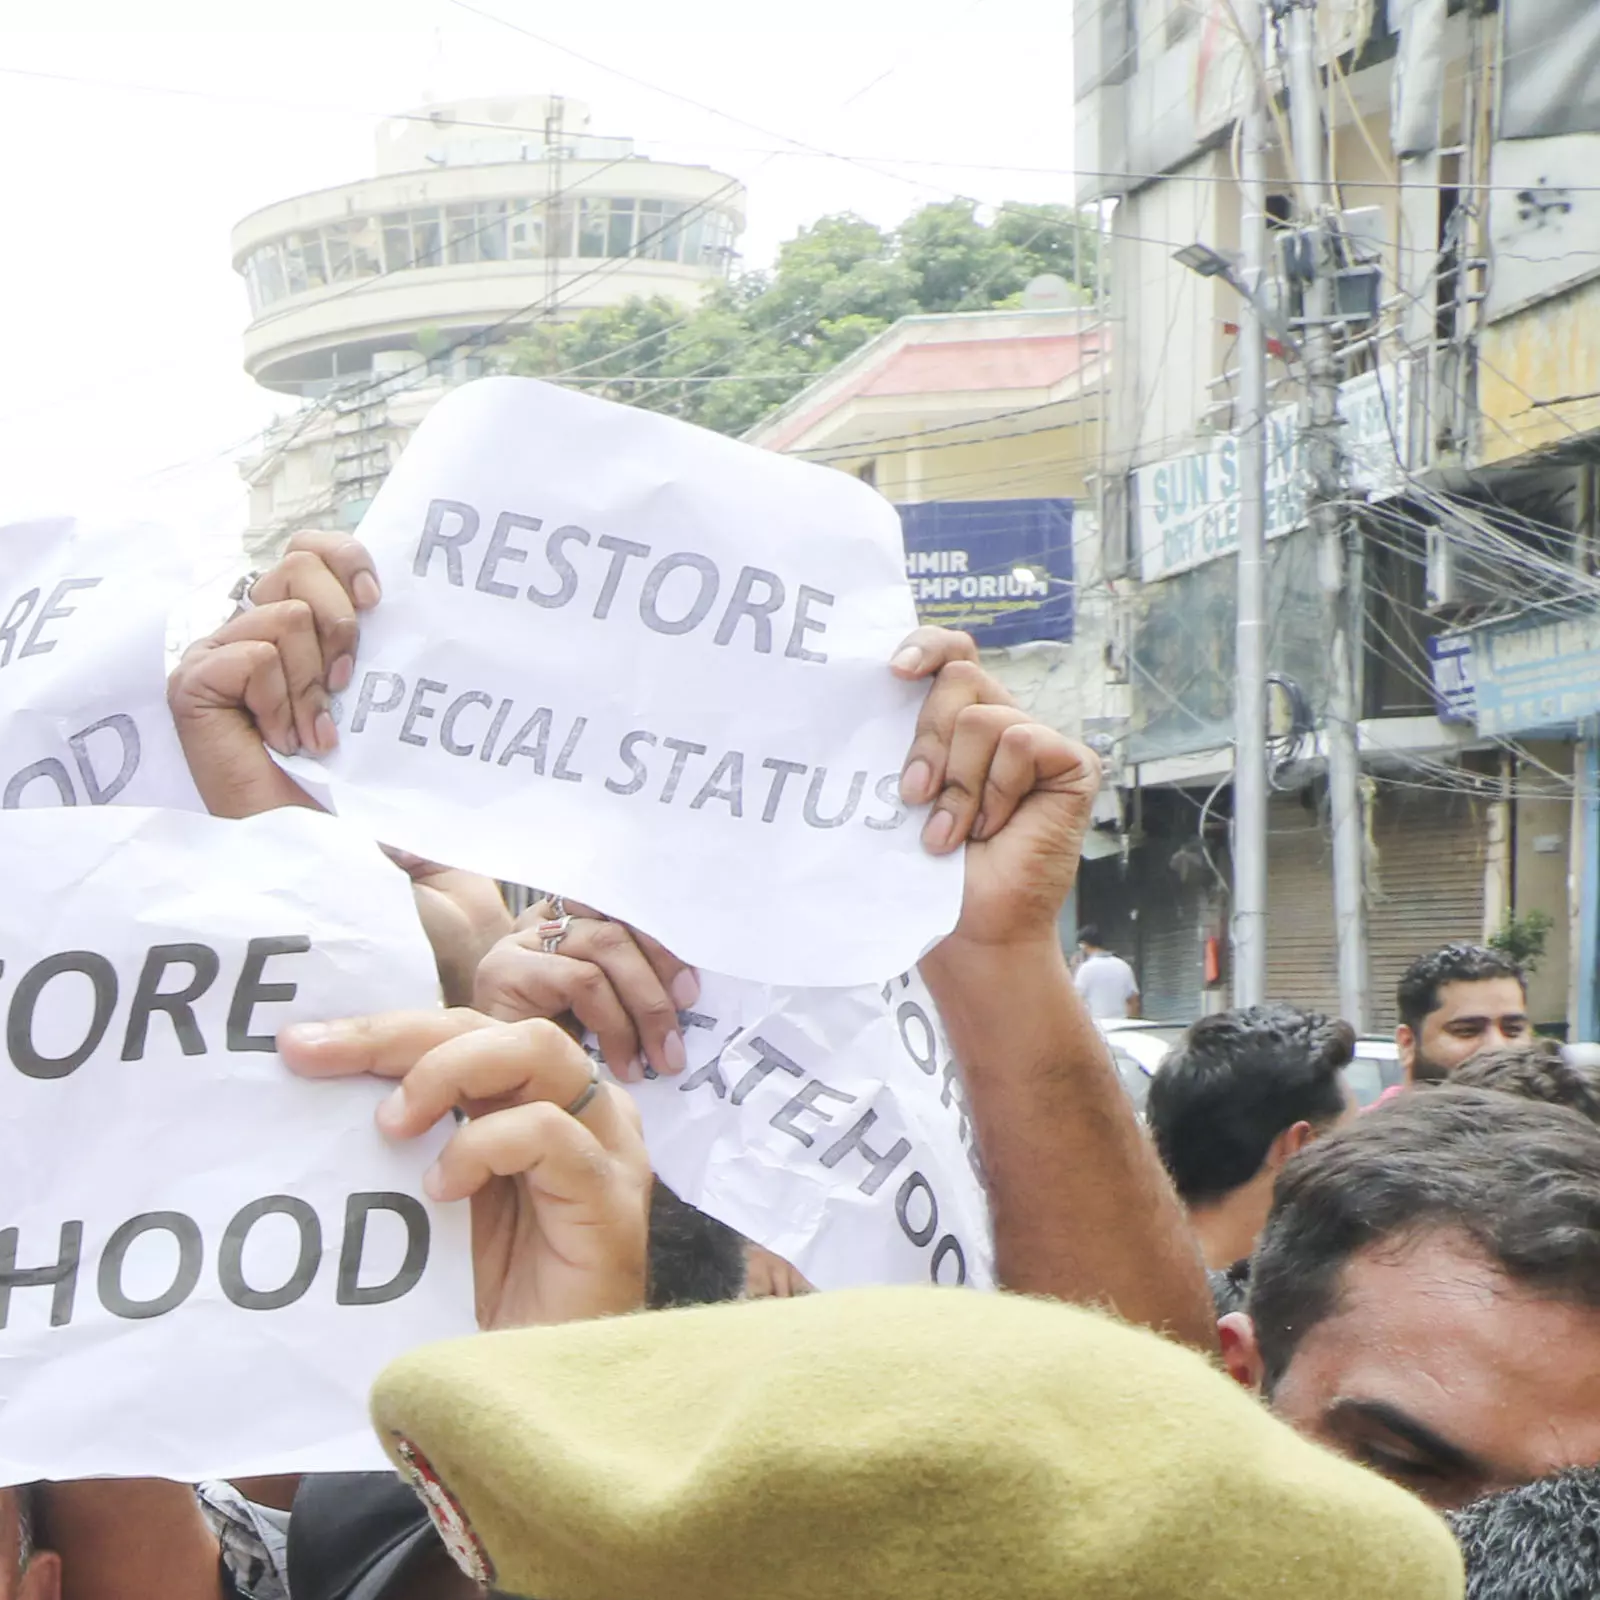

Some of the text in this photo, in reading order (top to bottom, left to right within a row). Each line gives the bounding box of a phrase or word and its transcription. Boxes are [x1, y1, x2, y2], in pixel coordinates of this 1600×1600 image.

[413, 498, 836, 665] RESTORE
[331, 671, 905, 831] PECIAL STATUS
